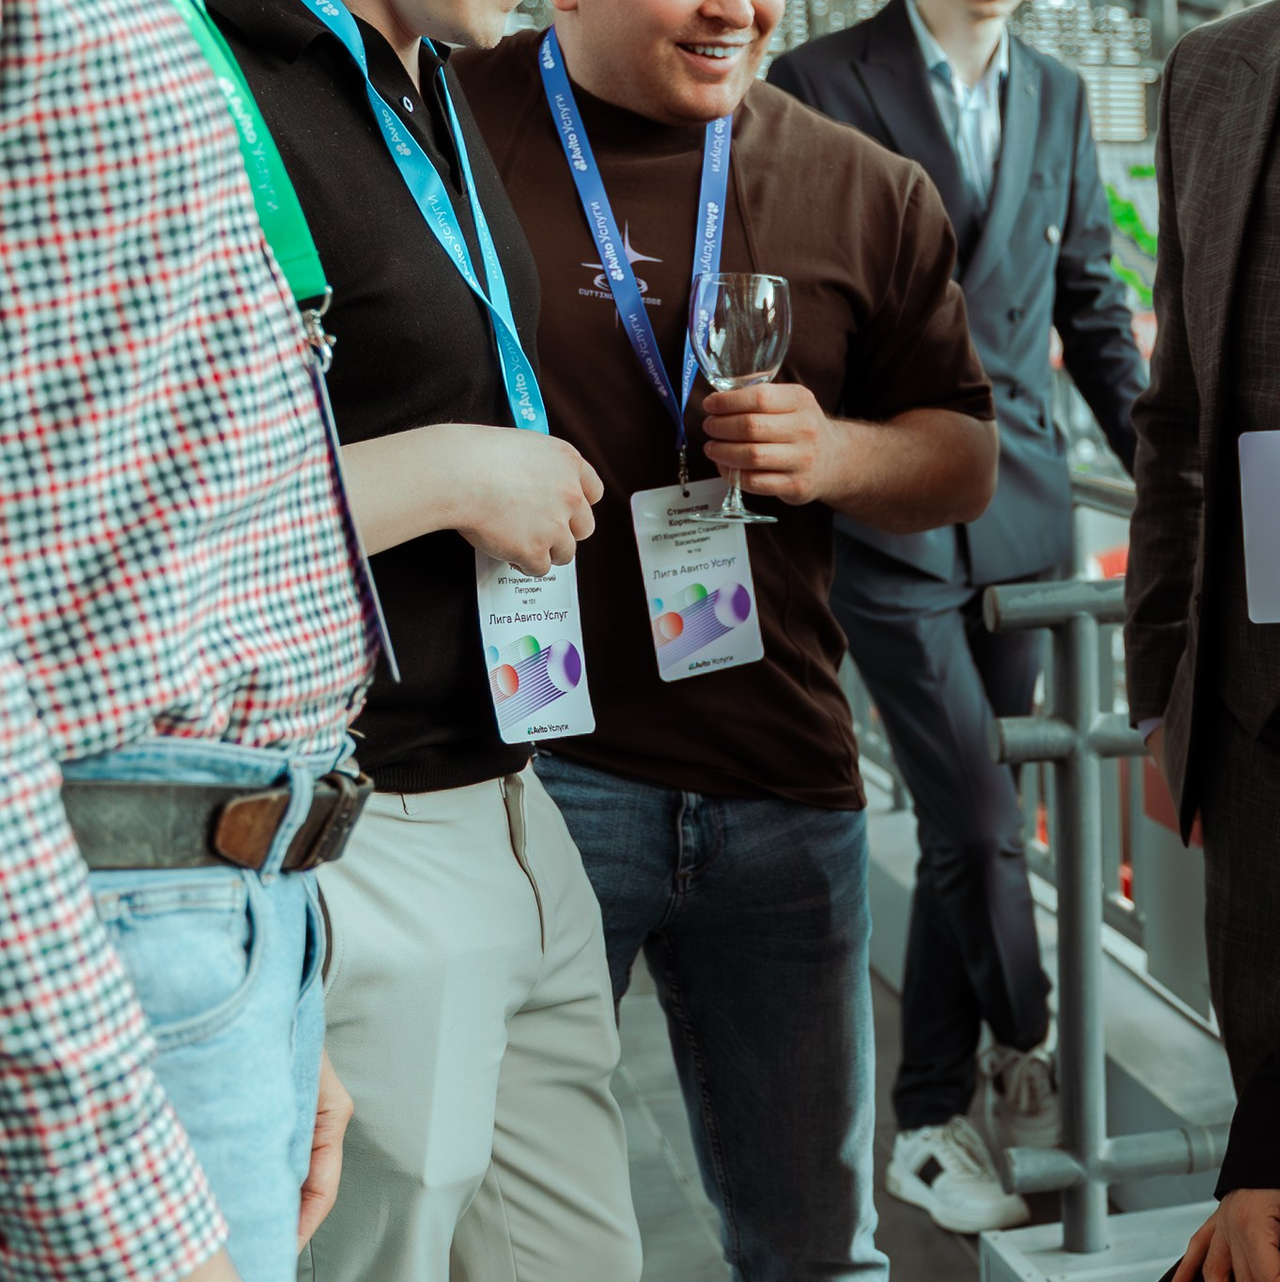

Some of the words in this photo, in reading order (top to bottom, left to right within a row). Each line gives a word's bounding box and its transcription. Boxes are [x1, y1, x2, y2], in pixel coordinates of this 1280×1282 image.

[381, 109, 404, 144] Avito
[555, 94, 575, 135] Услуги
[714, 117, 724, 135] ito
[568, 133, 583, 161] Avito
[709, 134, 726, 173] Услуги
[427, 194, 455, 246] Услуги
[590, 201, 612, 244] Услуги
[704, 209, 720, 239] Avito
[453, 242, 471, 279] Avito
[605, 242, 622, 271] Avito
[629, 313, 652, 356] Услуги
[514, 373, 532, 407] Avito
[645, 357, 664, 392] Avito
[653, 569, 678, 580] Лига
[680, 562, 710, 575] Авито
[710, 556, 737, 570] Услуг
[515, 586, 542, 595] Петрович
[489, 613, 513, 626] Лига
[514, 611, 543, 624] Авито
[543, 609, 569, 624] Услуг
[533, 725, 549, 735] Avito
[548, 722, 570, 735] Услуги
